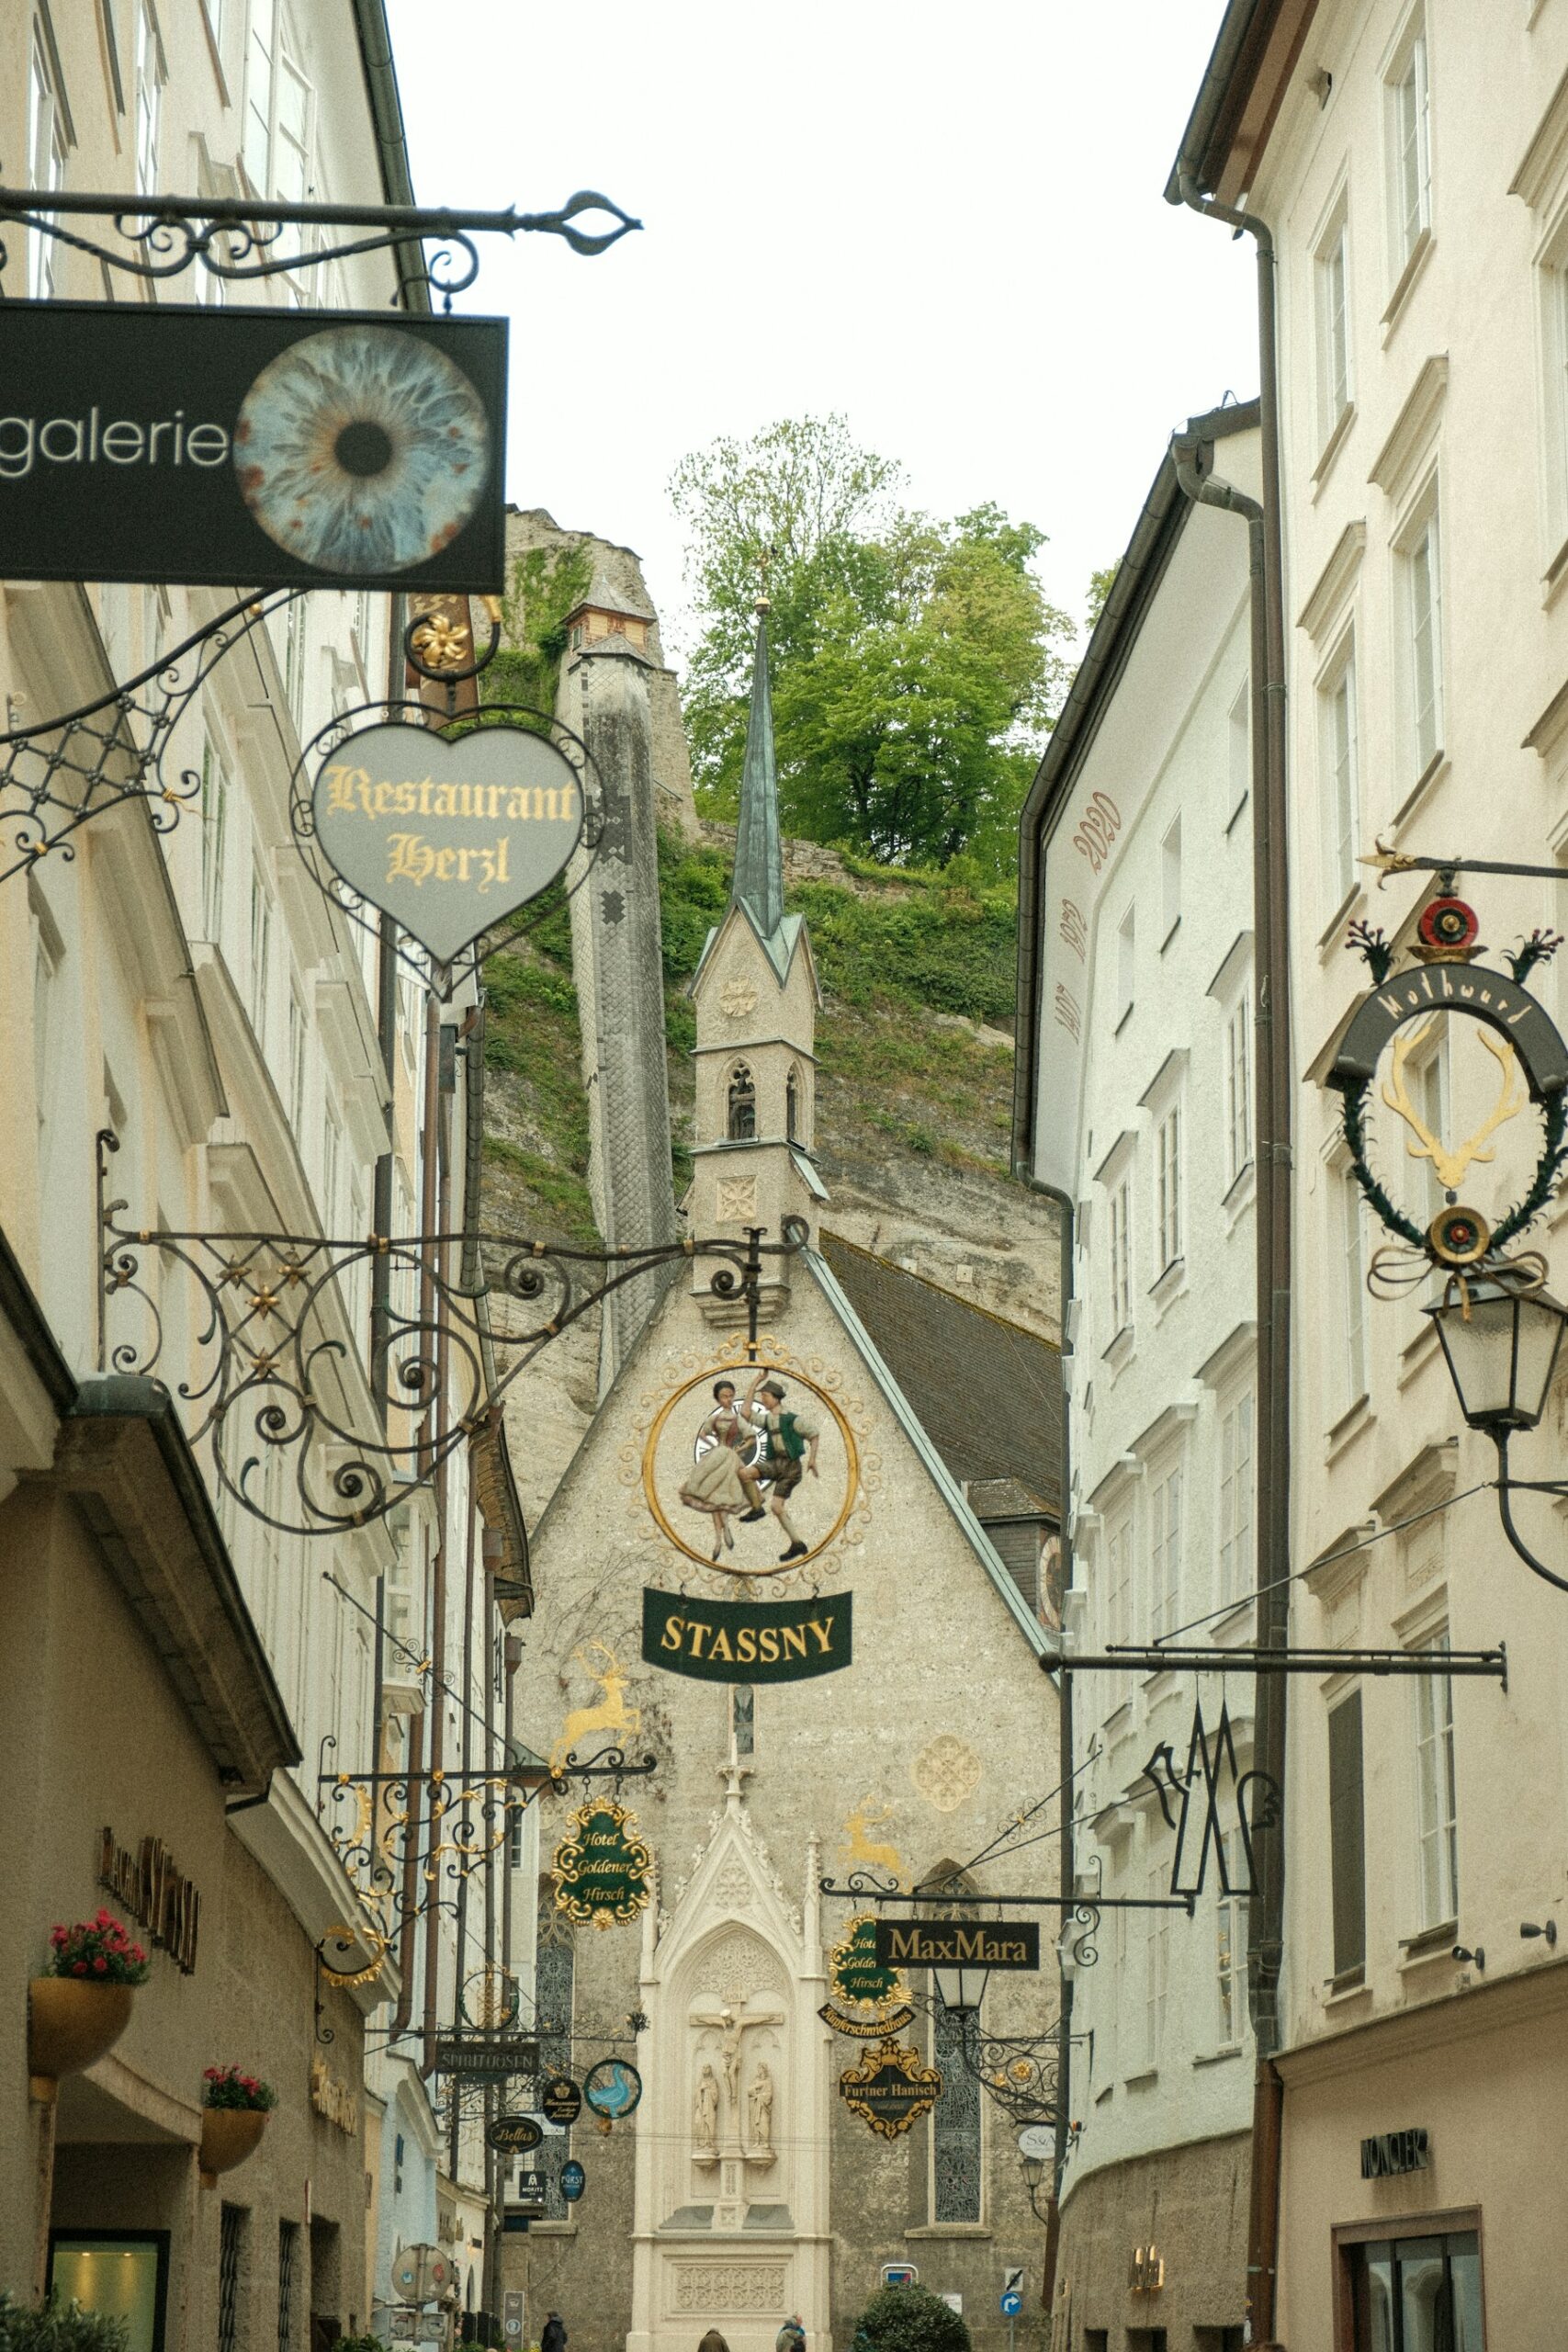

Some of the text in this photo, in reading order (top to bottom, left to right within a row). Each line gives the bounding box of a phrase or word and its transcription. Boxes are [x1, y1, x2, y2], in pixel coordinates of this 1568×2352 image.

[0, 406, 230, 478] galerie
[323, 764, 576, 820] Restaurant
[1073, 791, 1121, 876] 2020
[386, 832, 511, 894] Herzl
[660, 1615, 835, 1663] STASSNY
[582, 1832, 620, 1846] Hotel
[578, 1860, 632, 1875] Goldener
[582, 1886, 625, 1902] Hirsch
[888, 1928, 1027, 1962] MaxMara
[850, 1976, 883, 1988] Hirsch
[821, 2007, 912, 2036] Kupferschmiedhaus
[844, 2083, 937, 2097] Furtner Hanisch
[1360, 2128, 1427, 2179] MONCLER
